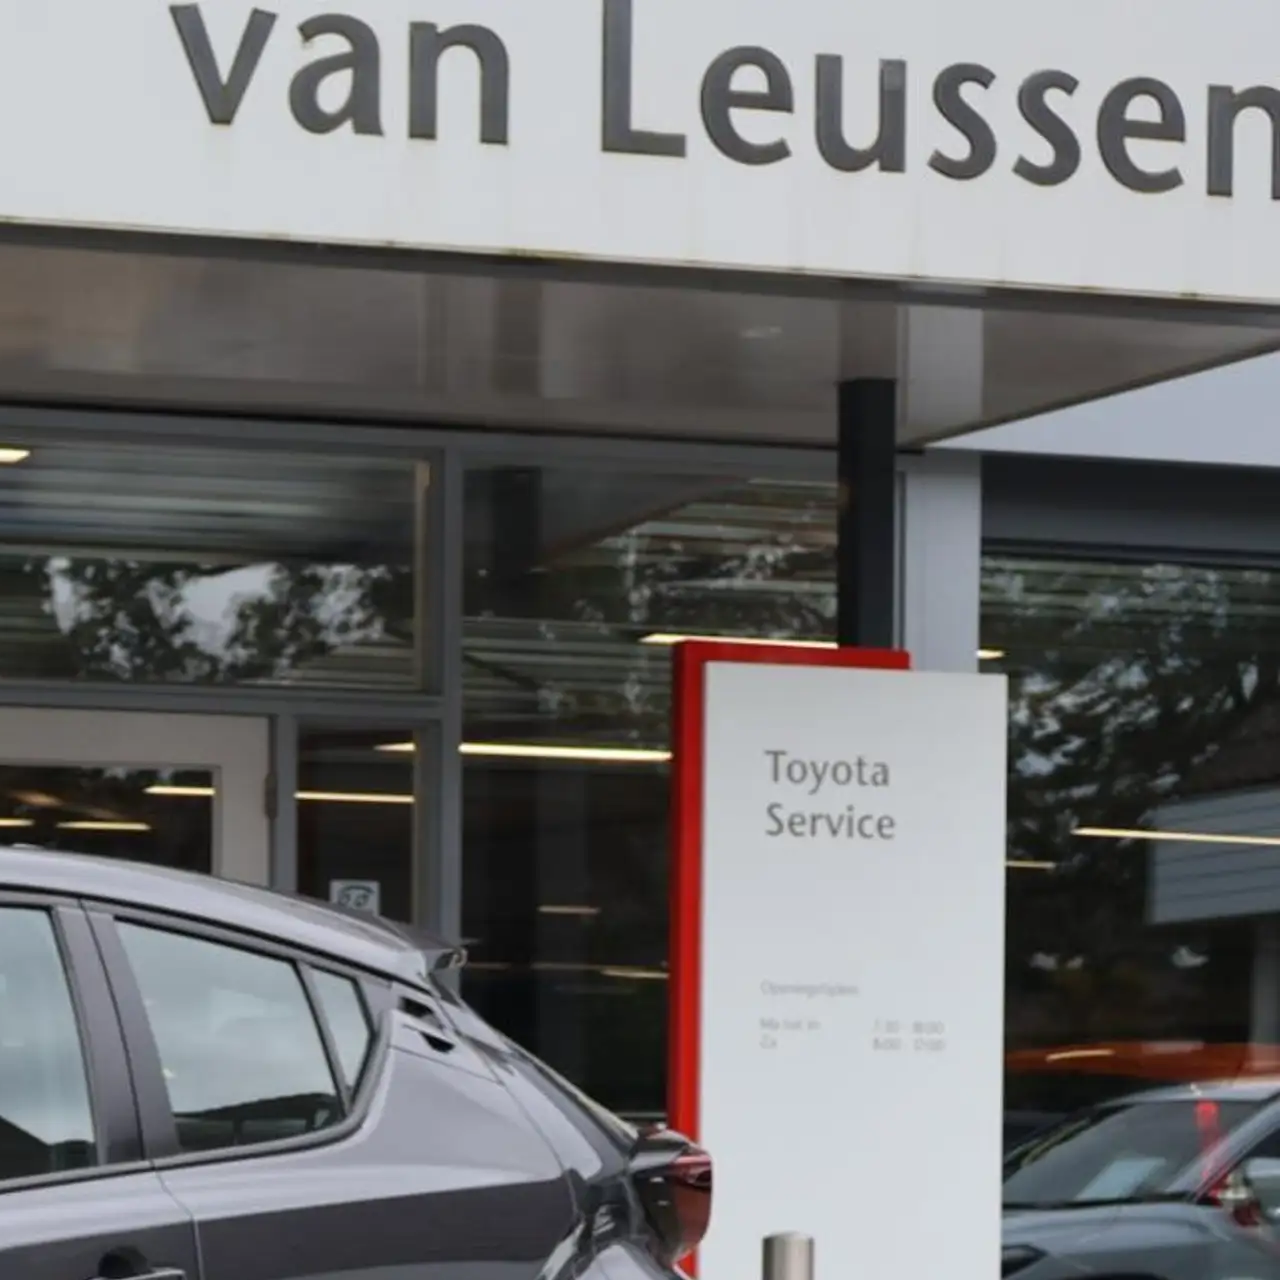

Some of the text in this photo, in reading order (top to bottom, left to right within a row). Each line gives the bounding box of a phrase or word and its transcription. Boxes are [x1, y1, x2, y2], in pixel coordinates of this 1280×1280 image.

[168, 0, 1280, 202] van Leussen
[764, 750, 890, 796] Toyota
[765, 802, 896, 840] Service
